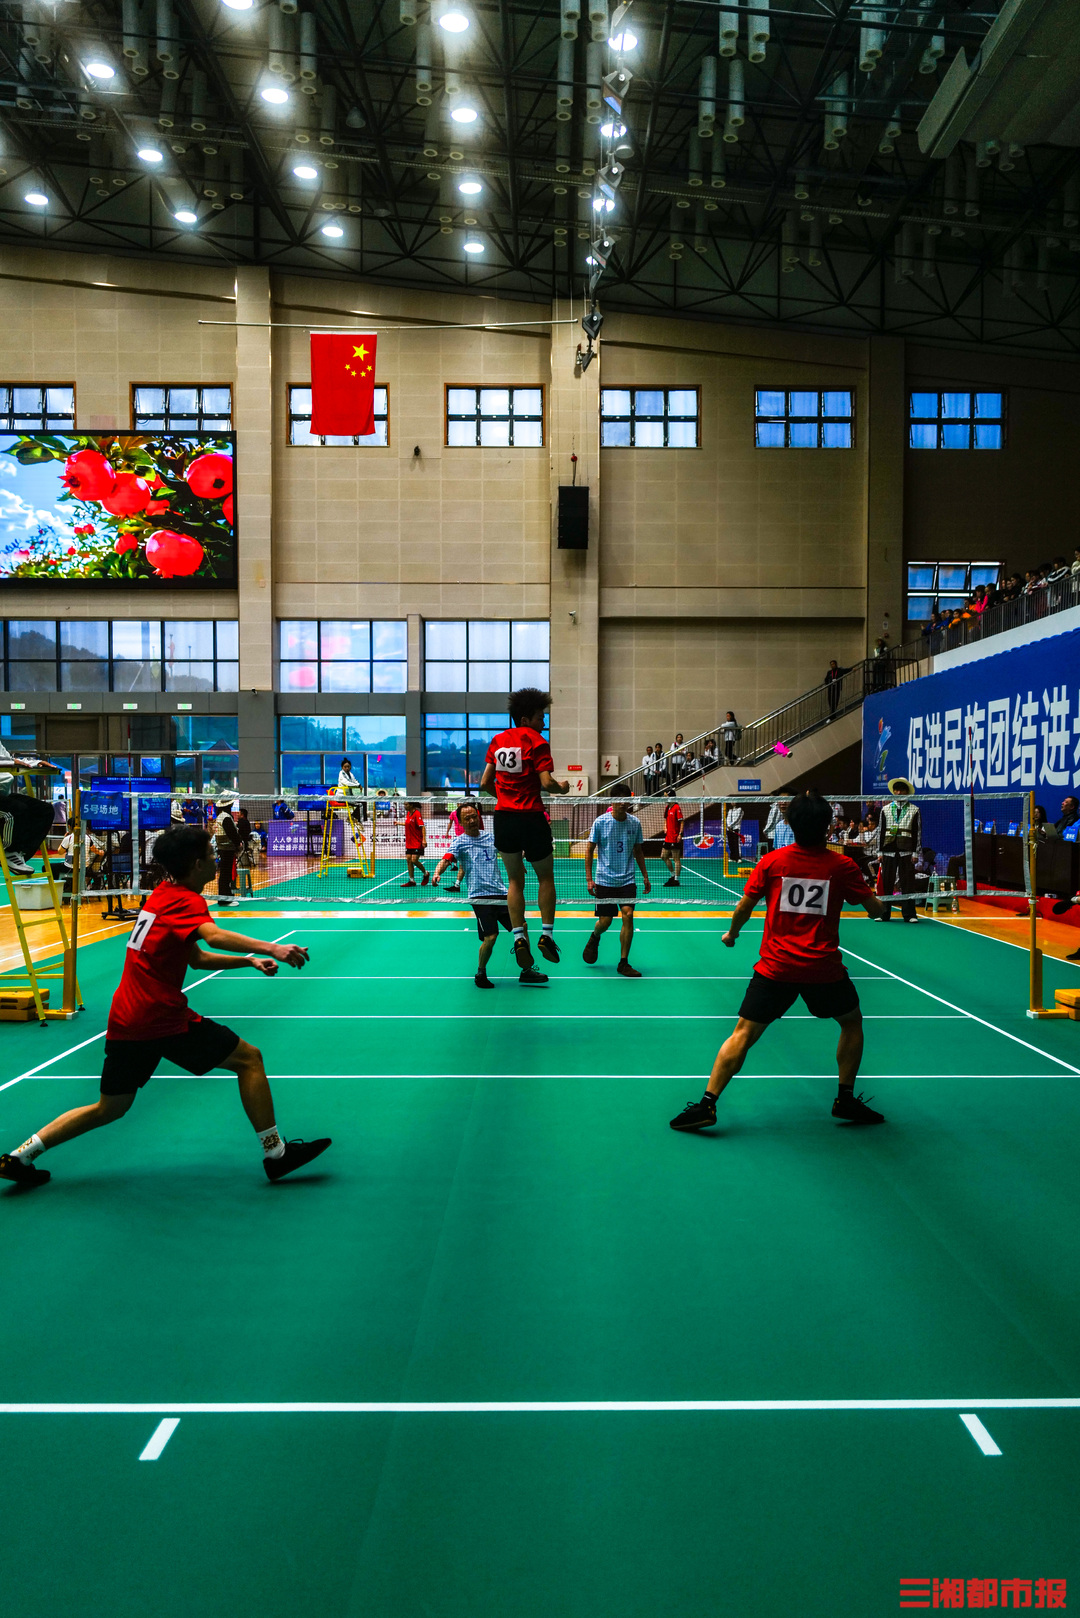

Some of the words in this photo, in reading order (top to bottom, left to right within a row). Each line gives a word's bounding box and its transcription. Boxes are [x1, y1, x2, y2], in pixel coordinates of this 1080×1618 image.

[497, 751, 517, 769] 03
[83, 804, 119, 815] 5号场地
[616, 841, 624, 853] 3
[483, 849, 492, 861] 1
[788, 883, 824, 909] 02
